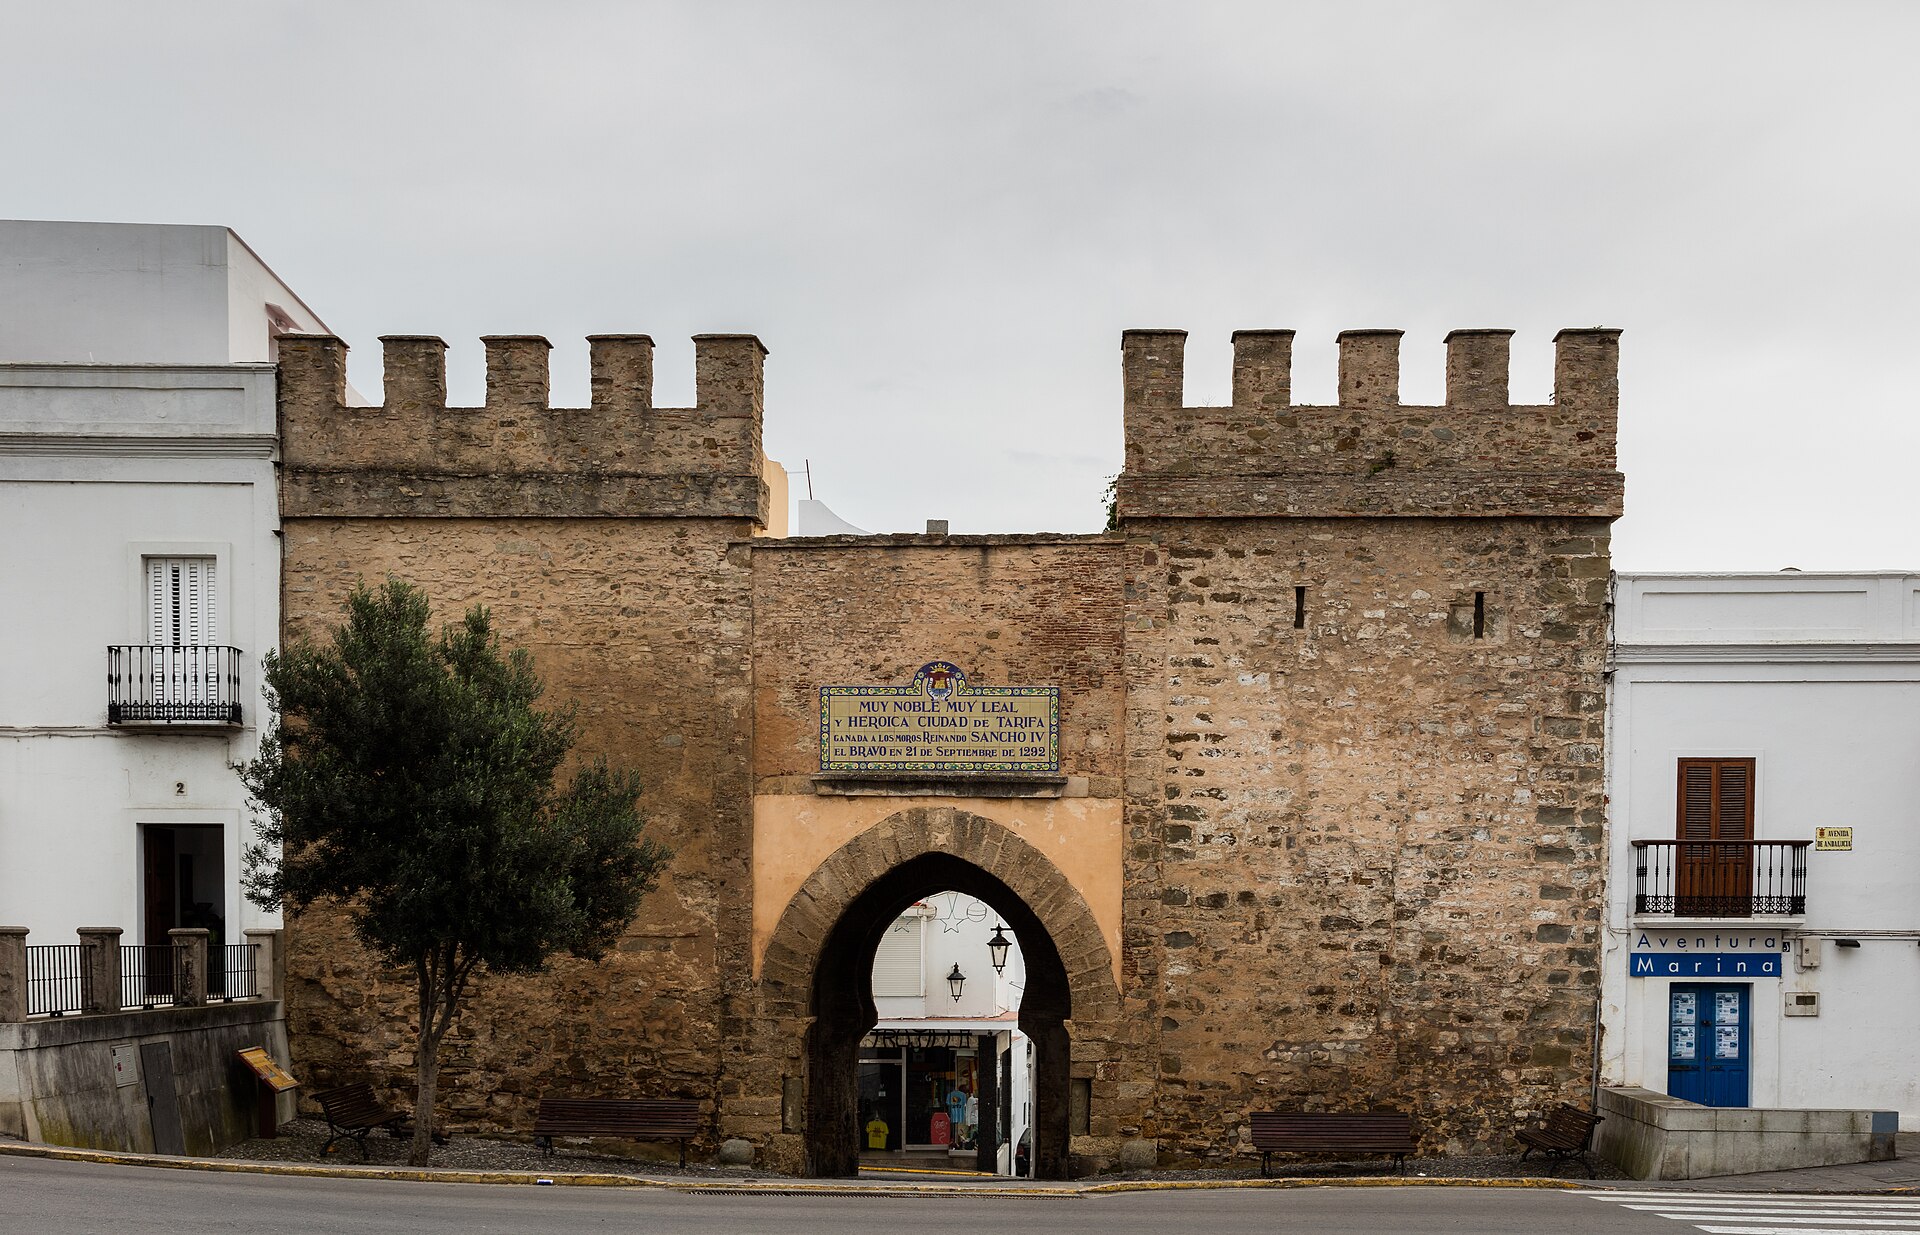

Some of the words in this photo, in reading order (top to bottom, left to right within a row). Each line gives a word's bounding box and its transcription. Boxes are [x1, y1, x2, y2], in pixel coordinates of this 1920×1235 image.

[858, 701, 889, 713] MUY
[893, 701, 940, 713] NOBLE
[946, 700, 977, 713] MUY
[981, 701, 1019, 713] LEAL
[834, 719, 843, 727] Y
[848, 716, 909, 729] HEROICA
[917, 716, 968, 728] CIUDAD
[973, 719, 990, 728] DE
[996, 716, 1045, 729] TARIFA
[833, 734, 870, 743] GANADA
[871, 734, 877, 743] A
[878, 734, 894, 743] LOS
[895, 734, 922, 744] MOROS
[970, 731, 1026, 743] SANCHO
[1030, 731, 1045, 743] IV
[834, 748, 846, 757] EL
[849, 746, 887, 757] BRAVO
[889, 748, 903, 757] EN
[905, 746, 917, 757] 21
[920, 748, 933, 757] DE
[1002, 748, 1015, 757] DE
[1019, 746, 1046, 757] 1292
[176, 782, 185, 794] 2
[1817, 840, 1823, 848] DE
[1636, 933, 1776, 948] Aventura
[1636, 957, 1773, 973] Marina
